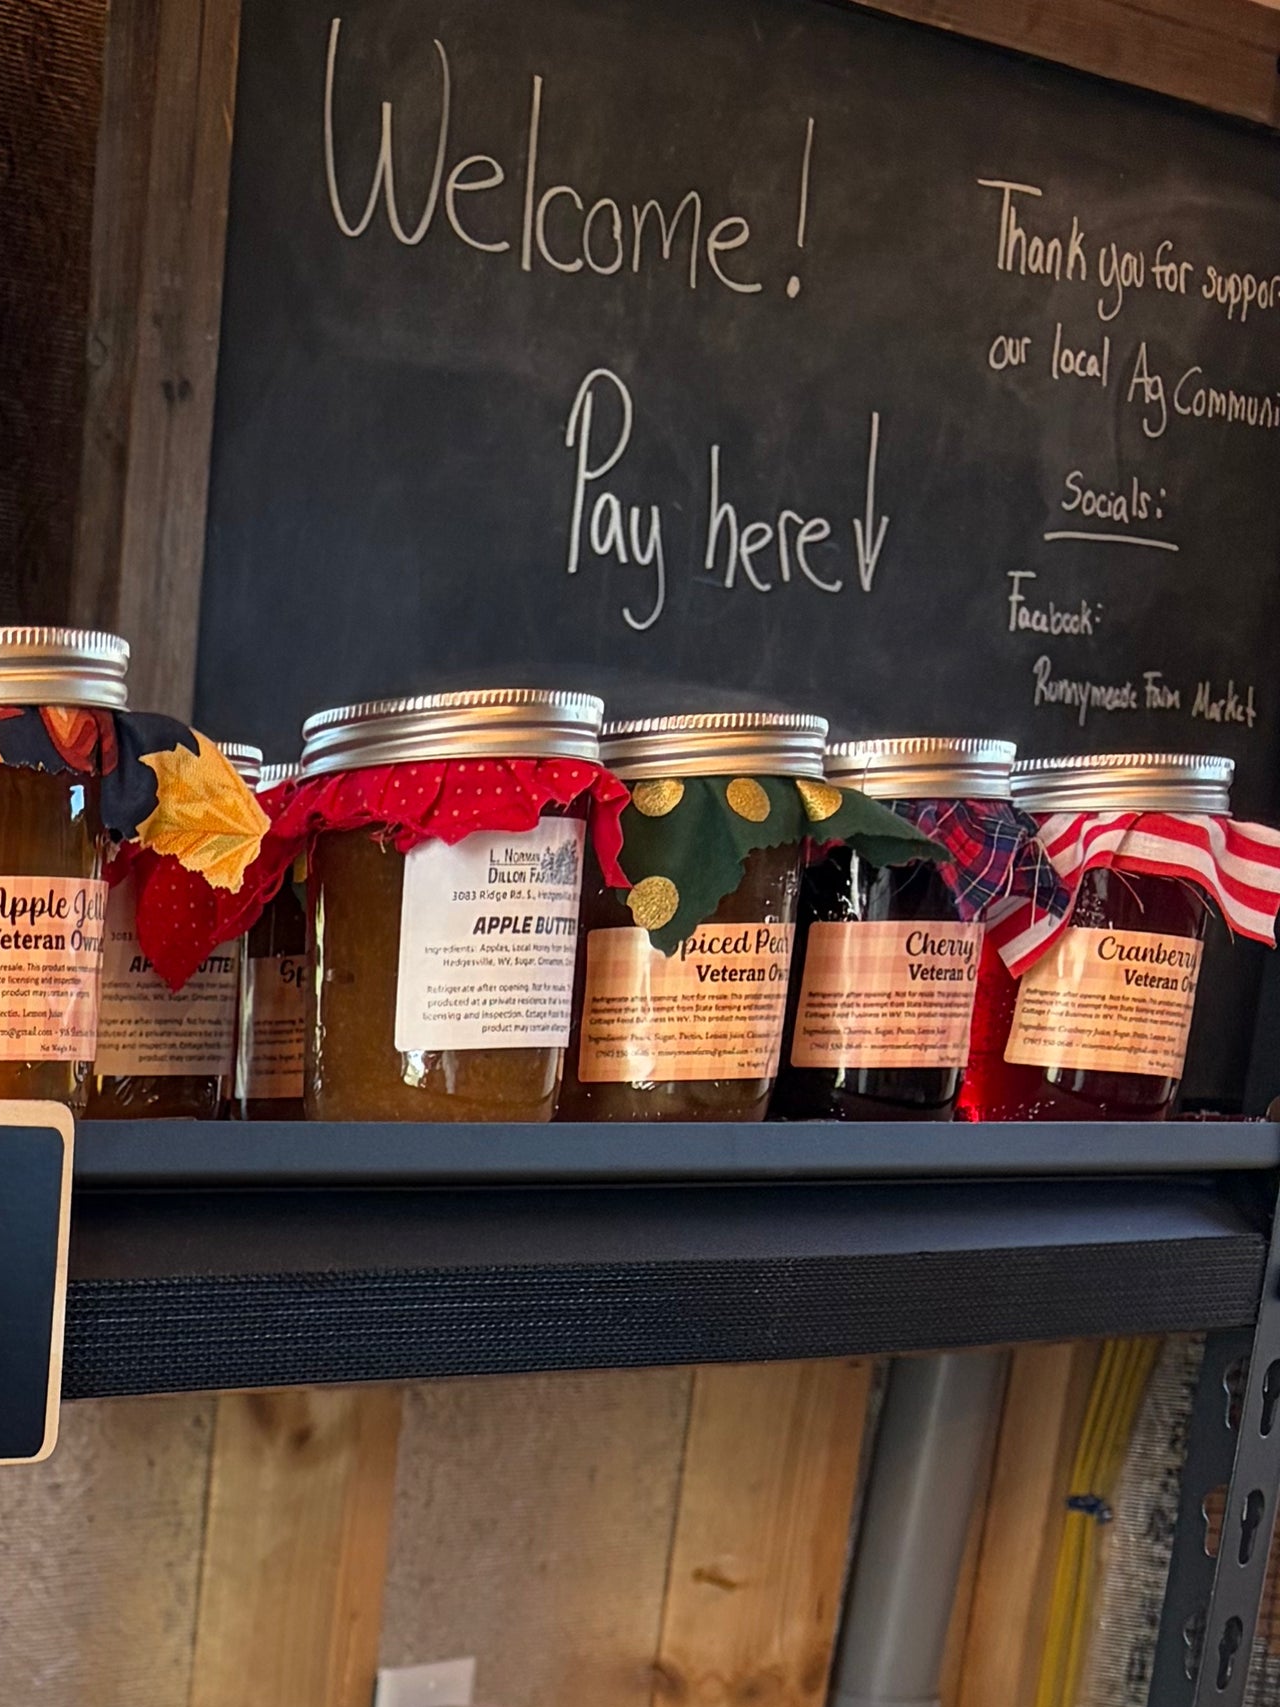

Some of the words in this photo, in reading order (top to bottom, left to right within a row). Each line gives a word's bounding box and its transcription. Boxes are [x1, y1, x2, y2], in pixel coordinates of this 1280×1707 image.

[325, 17, 815, 300] Welcome!
[977, 178, 1087, 282] Thank
[1097, 242, 1146, 322] you
[1150, 240, 1195, 294] for
[1202, 265, 1280, 323] suppor
[988, 334, 1033, 371] our
[1051, 322, 1111, 389] local
[1126, 341, 1168, 439] Ag
[1173, 366, 1280, 428] Communi
[565, 367, 667, 631] Pay
[704, 444, 843, 593] here
[1060, 469, 1168, 524] Socials:
[1006, 569, 1104, 635] Facebook:
[472, 916, 534, 936] APPLE
[677, 927, 751, 961] piced
[906, 930, 974, 962] Cherry
[1096, 935, 1199, 971] Cranberry
[696, 963, 766, 983] Veteran
[907, 961, 964, 981] Veteran
[1123, 967, 1178, 990] Veteran
